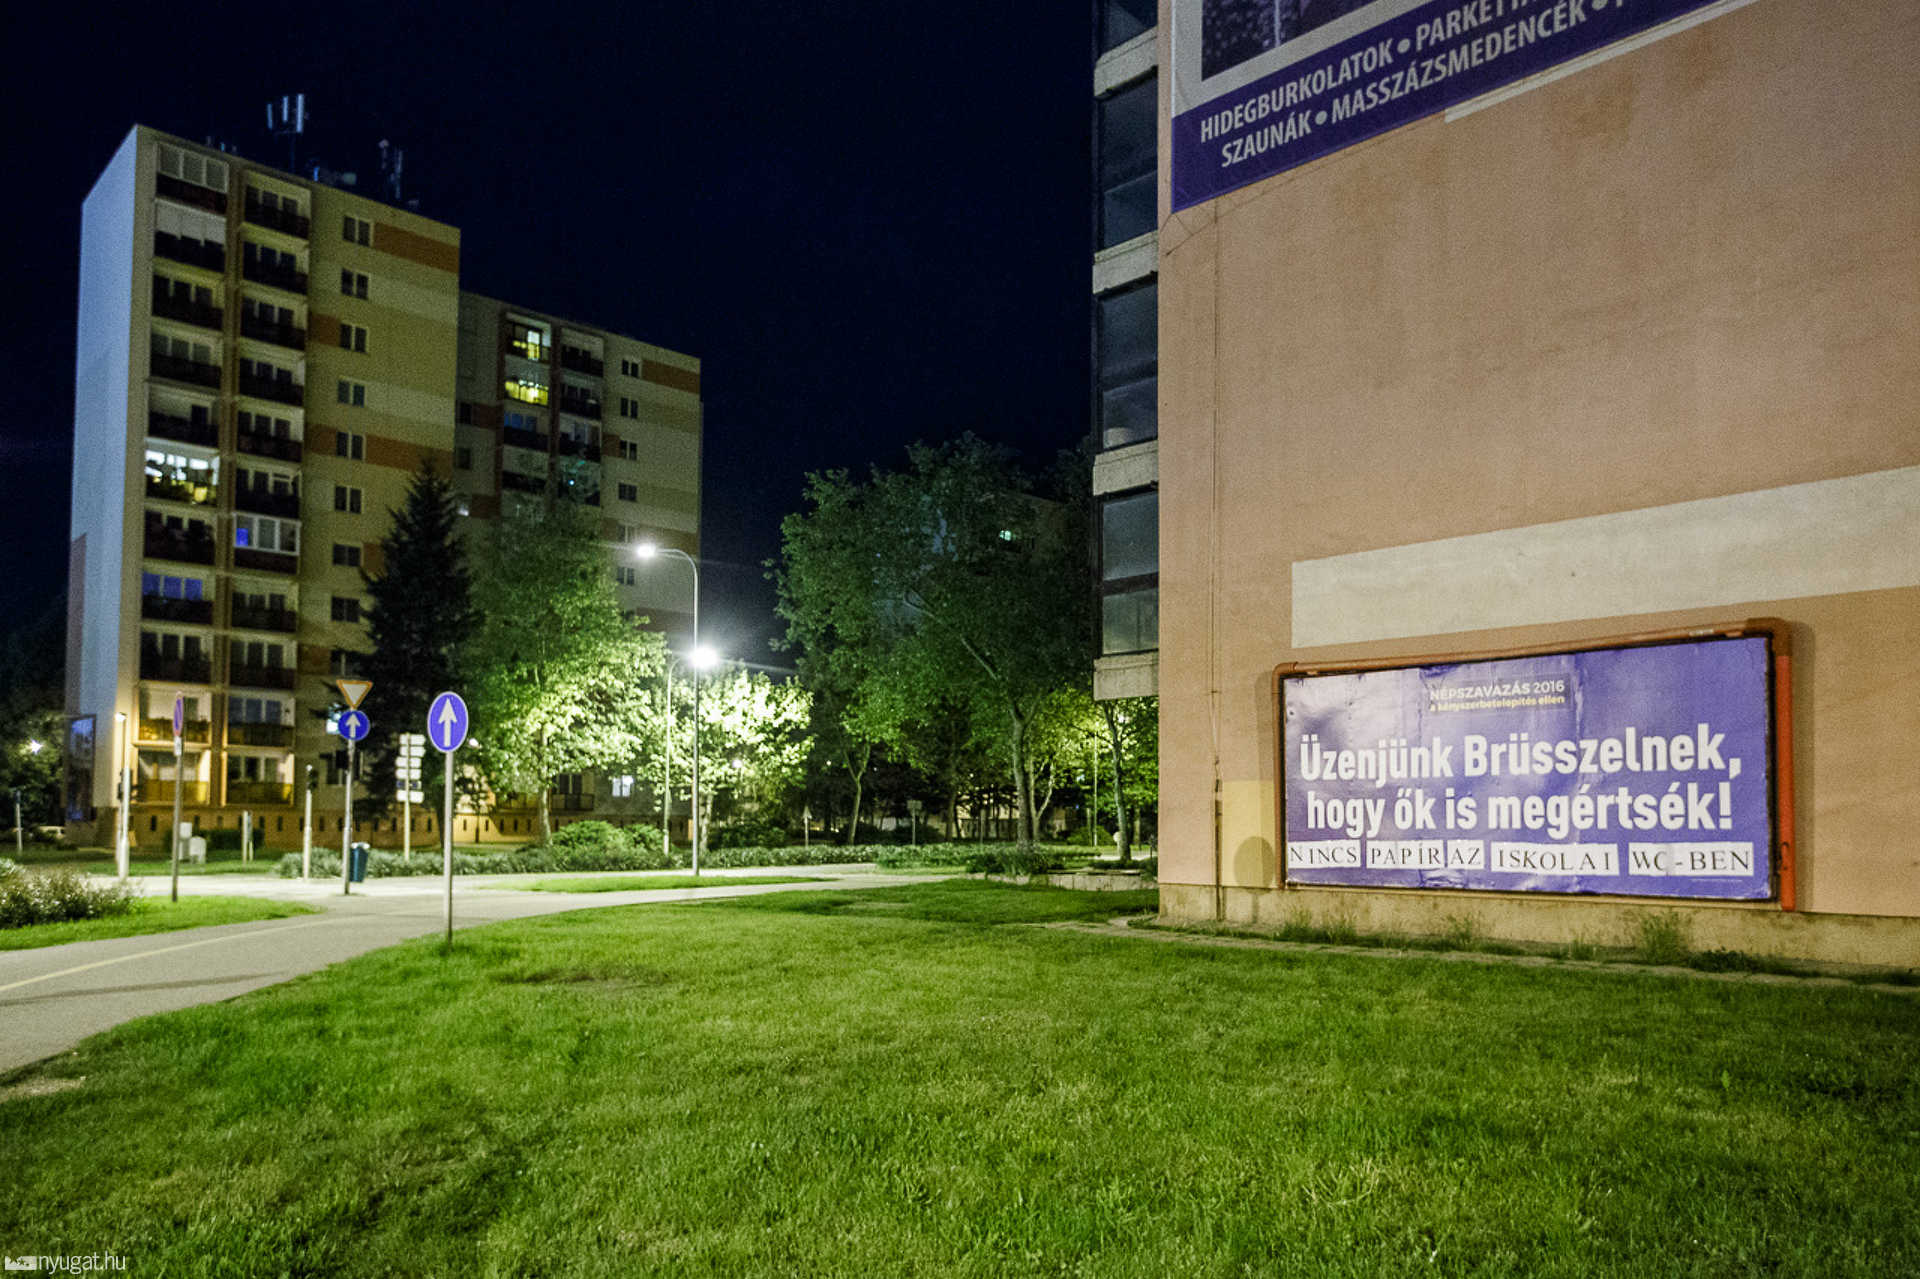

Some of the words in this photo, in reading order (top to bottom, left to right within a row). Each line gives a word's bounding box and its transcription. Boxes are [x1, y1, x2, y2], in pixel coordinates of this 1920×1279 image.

[1200, 38, 1394, 143] HIDEGBURKOLATOK
[1221, 110, 1312, 168] SZAUNÁK
[1331, 0, 1587, 124] MASSZÁZSMEDENCÉK
[1429, 681, 1531, 701] NÉPSZAVAZÁS
[1533, 680, 1566, 695] 2016
[1300, 734, 1455, 788] Üzenjünk
[1464, 723, 1742, 780] Brüsszelnek,
[1307, 790, 1386, 839] hogy
[1394, 787, 1437, 830] ők
[1445, 787, 1478, 830] is
[1488, 781, 1734, 840] megértsék!
[1289, 846, 1358, 866] NINCS
[1450, 847, 1481, 866] AZ
[1498, 849, 1611, 872] ISKOLAI
